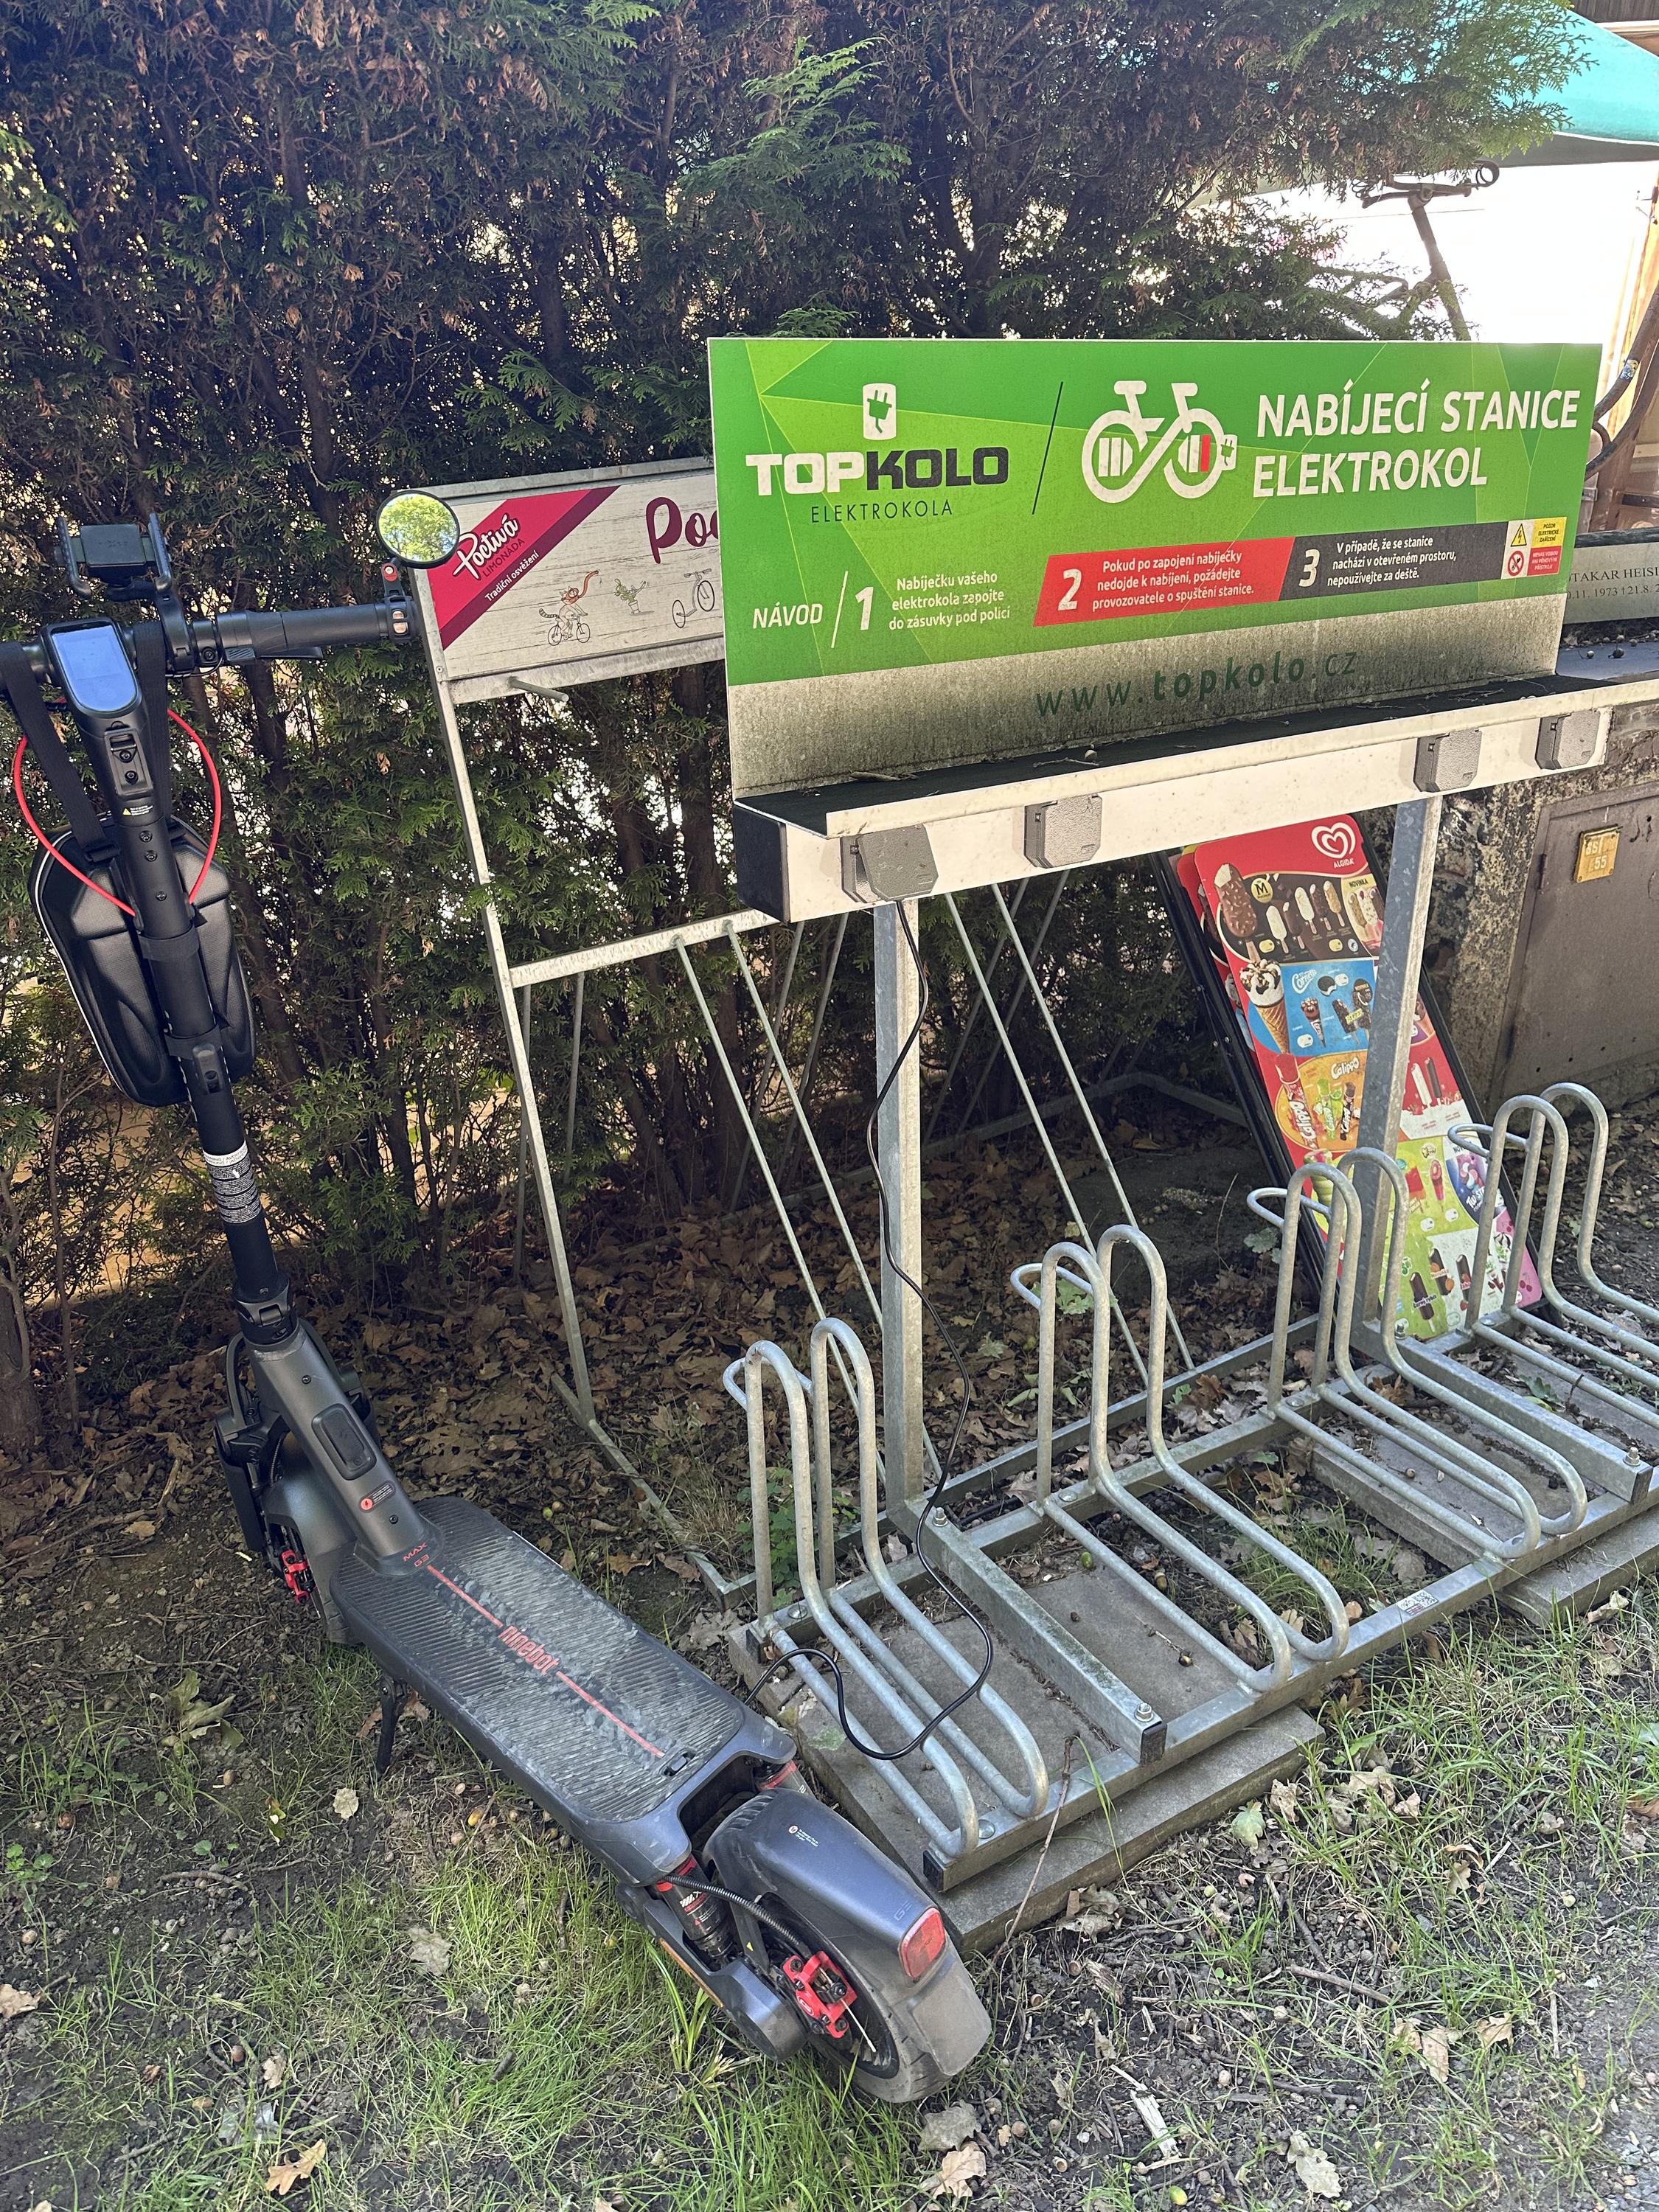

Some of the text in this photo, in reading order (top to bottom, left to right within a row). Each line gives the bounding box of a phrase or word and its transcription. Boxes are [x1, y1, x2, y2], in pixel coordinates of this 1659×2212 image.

[1256, 378, 1581, 437] NABÍJECÍ STANICE
[745, 447, 1009, 496] TOPKOLO
[1253, 447, 1488, 498] ELEKTROKOL
[811, 499, 953, 523] ELEKTROKOLA
[453, 513, 519, 580] Poctivá
[1336, 535, 1433, 555] V případě, že se stanice
[482, 538, 525, 577] LIMONÁDA
[1102, 550, 1242, 573] Pokud po zapojení nabíječky
[1298, 549, 1320, 588] 3
[1332, 550, 1457, 570] nachází v otevřeném prostoru,
[484, 549, 540, 602] Tradiční osvěžení
[897, 571, 998, 592] Nabíječku vašeho
[1097, 567, 1241, 592] nedojde k nabíjení, požádejte
[1327, 566, 1419, 588] nepoužívejte za deště.
[891, 588, 1004, 611] elektrokola zapojte
[1057, 568, 1082, 611] 2
[1092, 583, 1255, 612] provozovatele o spuštění stanice.
[1595, 587, 1618, 597] 1973
[752, 601, 824, 629] NÁVOD
[855, 587, 874, 630] 1
[888, 616, 904, 630] do
[906, 612, 953, 628] zásuvky
[956, 609, 977, 627] pod
[1036, 650, 1357, 717] www.topkolo.cz
[1333, 858, 1354, 869] ALGIDA
[1594, 855, 1607, 869] 55
[1253, 882, 1269, 895] M
[1331, 1057, 1360, 1079] Calippo
[403, 1542, 428, 1562] MAX
[498, 1625, 560, 1676] ninebot
